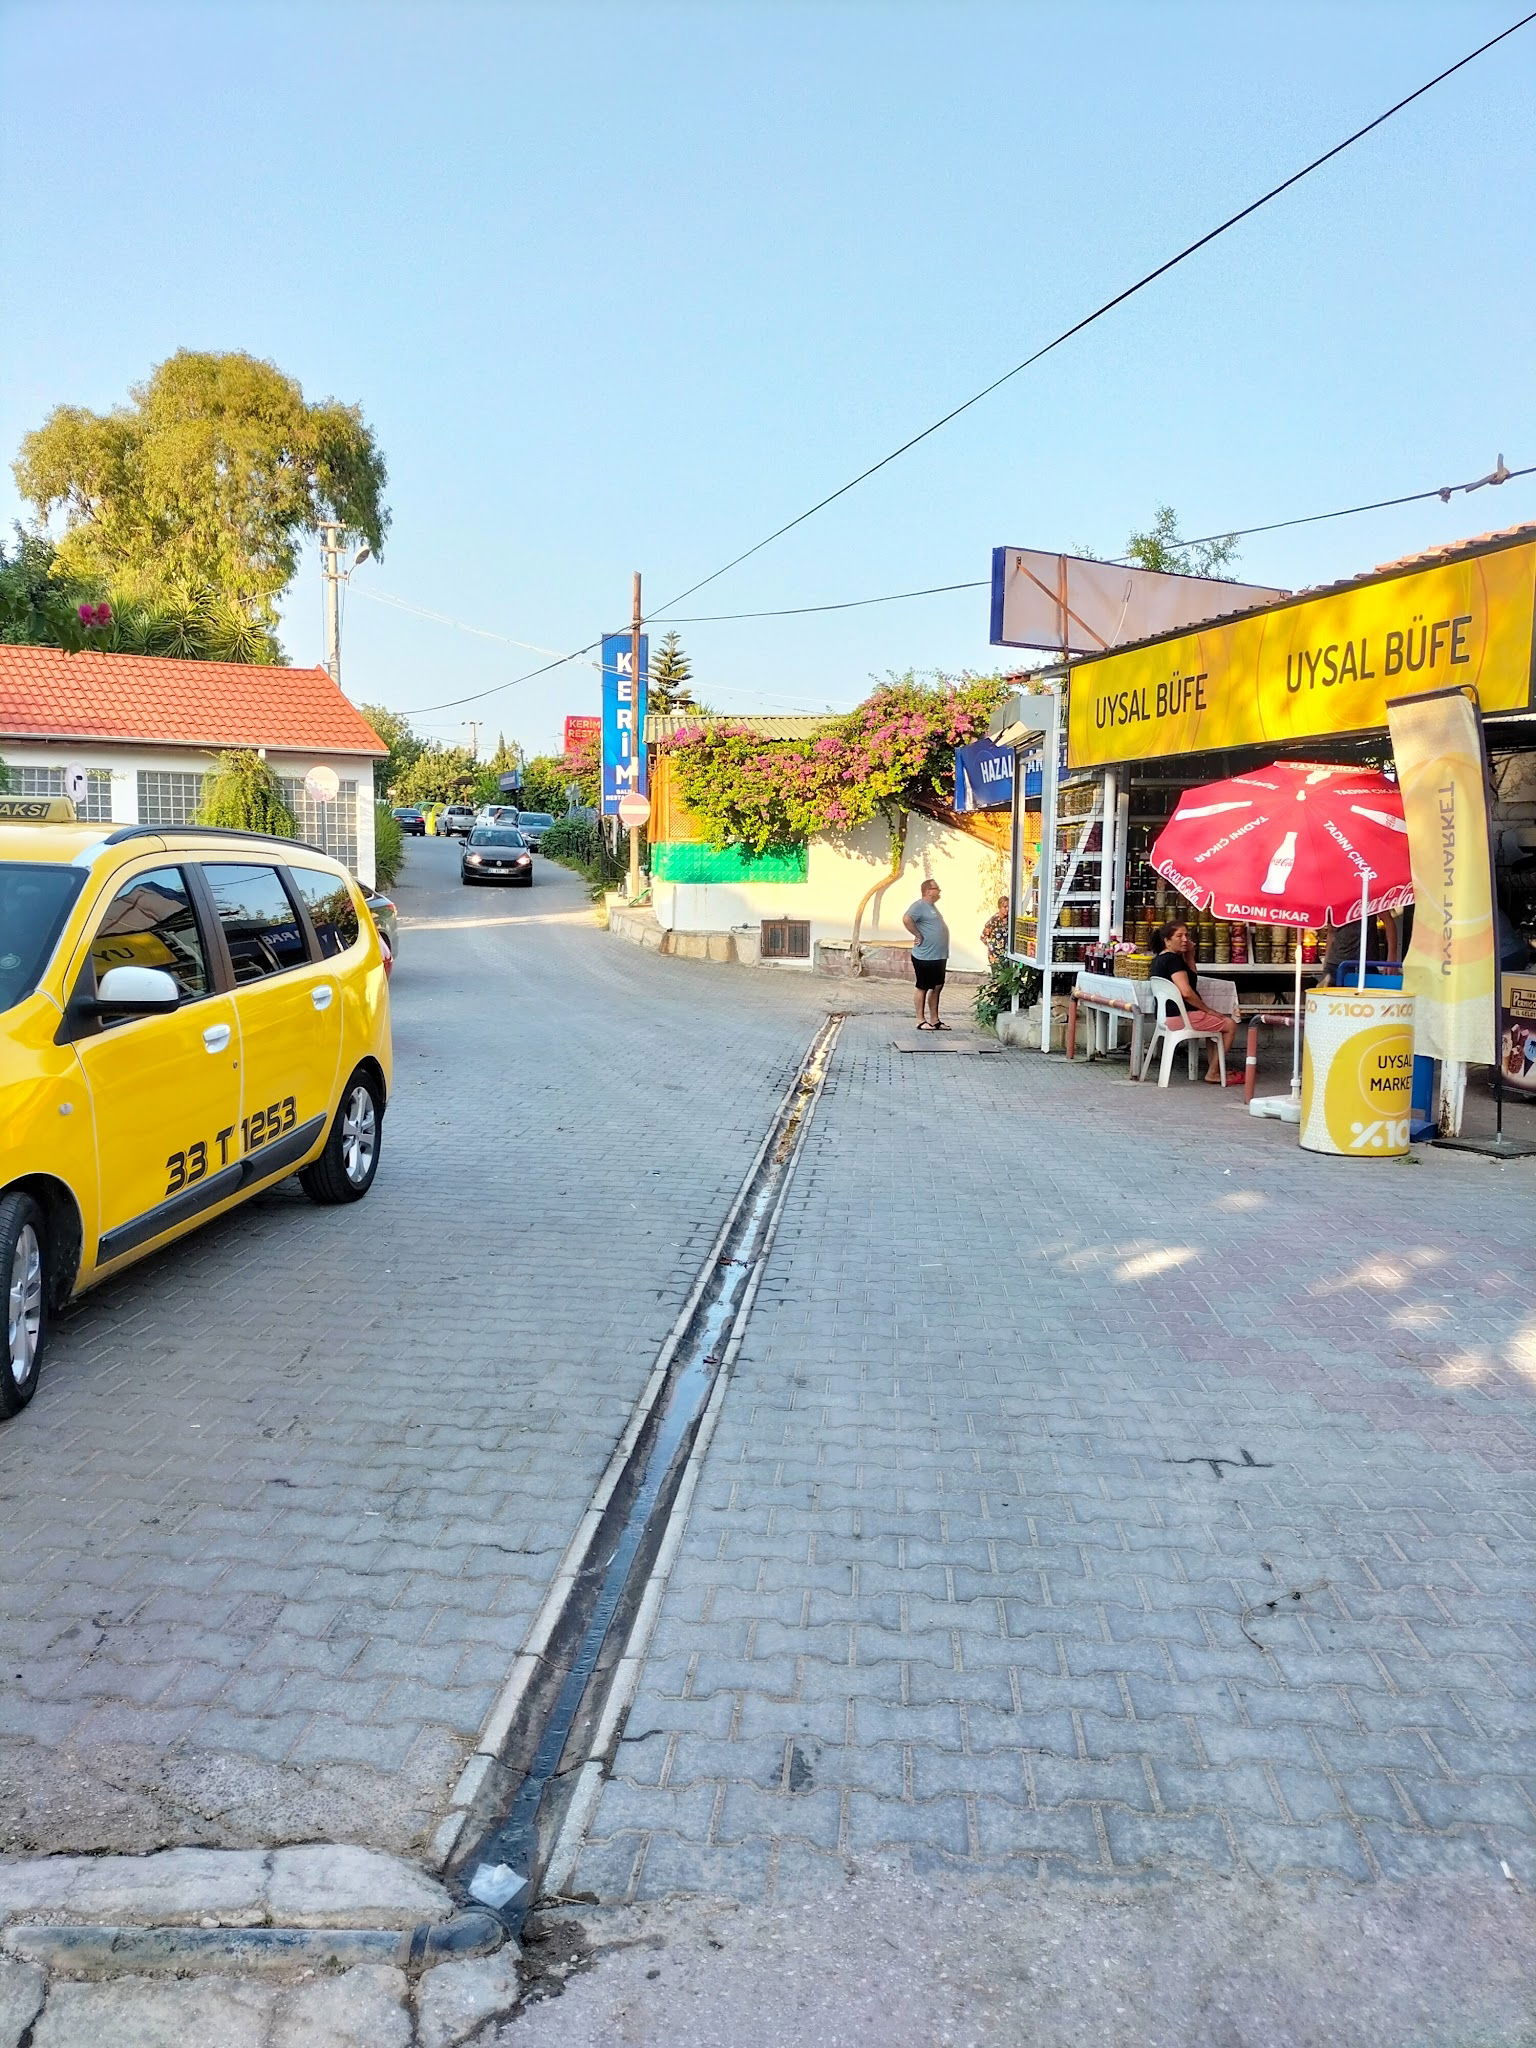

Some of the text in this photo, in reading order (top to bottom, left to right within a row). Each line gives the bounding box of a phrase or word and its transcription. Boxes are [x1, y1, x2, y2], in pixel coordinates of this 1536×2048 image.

[1288, 614, 1472, 693] UYSAL BÜFE
[1096, 670, 1208, 729] UYSAL BÜFE
[980, 755, 1014, 784] HAZAL
[0, 803, 49, 817] AKSİ
[1322, 820, 1354, 852] TADINI
[1224, 903, 1311, 923] TADINI ÇIKAR
[1328, 1003, 1376, 1018] %100
[1378, 1054, 1412, 1069] UYSAL
[165, 1094, 297, 1198] 33 T 1253
